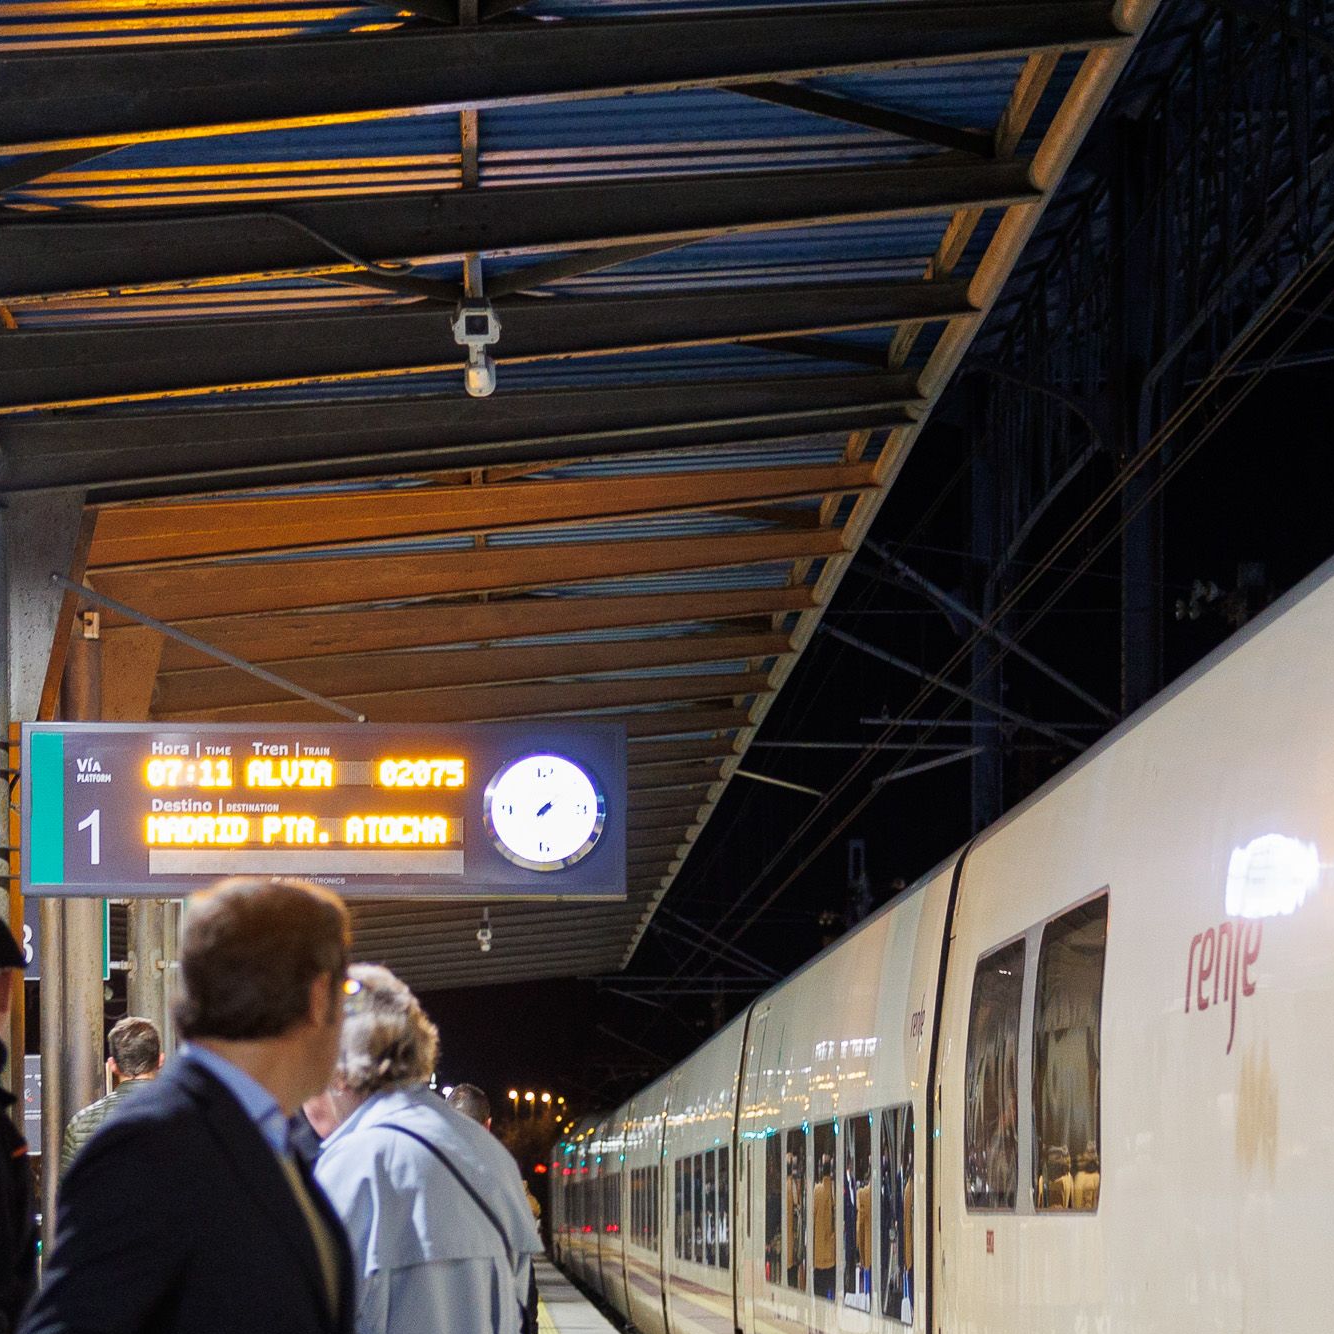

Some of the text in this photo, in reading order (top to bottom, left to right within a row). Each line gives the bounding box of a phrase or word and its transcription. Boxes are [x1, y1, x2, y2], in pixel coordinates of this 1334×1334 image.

[151, 741, 231, 756] Hora TIME
[252, 741, 331, 756] Tren TRAIN
[76, 773, 112, 783] PLATFORM
[147, 758, 465, 787] 07:11 ALVIA 02075
[151, 798, 280, 813] Destino DESTINATION
[78, 809, 101, 865] 1
[146, 815, 448, 844] MADRID PTA. ATOCHA
